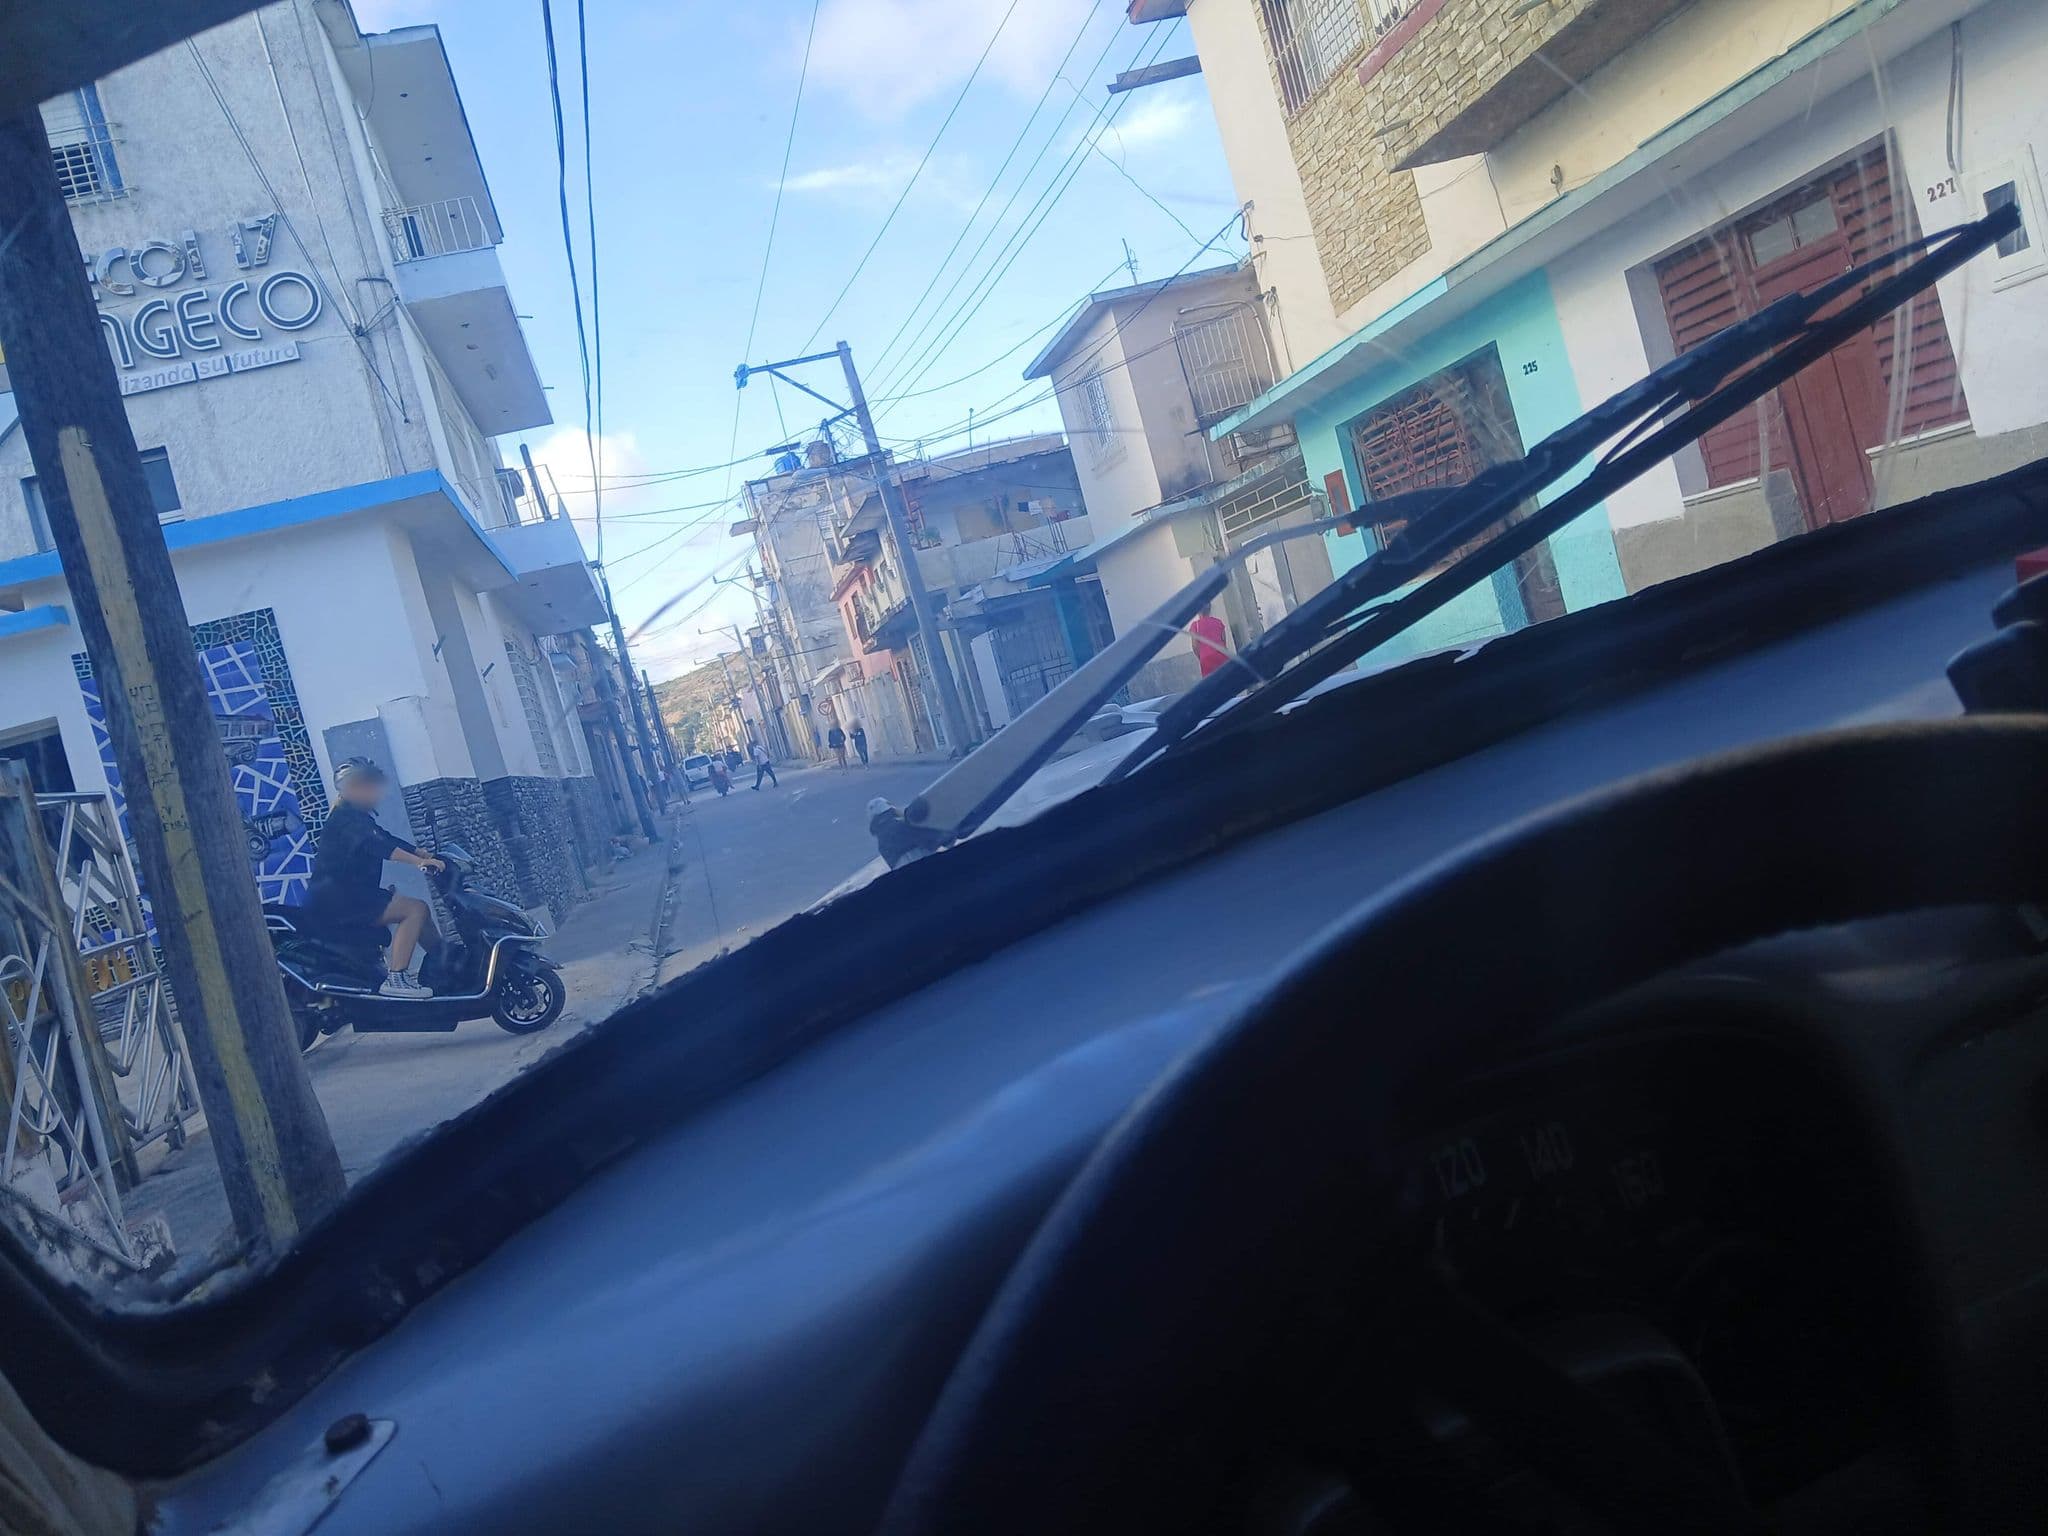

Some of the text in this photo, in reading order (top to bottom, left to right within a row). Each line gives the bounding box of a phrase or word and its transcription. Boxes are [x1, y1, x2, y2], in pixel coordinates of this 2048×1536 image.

[1926, 177, 1957, 203] 227
[80, 229, 208, 301] COI
[199, 356, 226, 375] su
[231, 344, 296, 371] futuro
[1522, 359, 1538, 376] 225
[1428, 1137, 1488, 1200] 120
